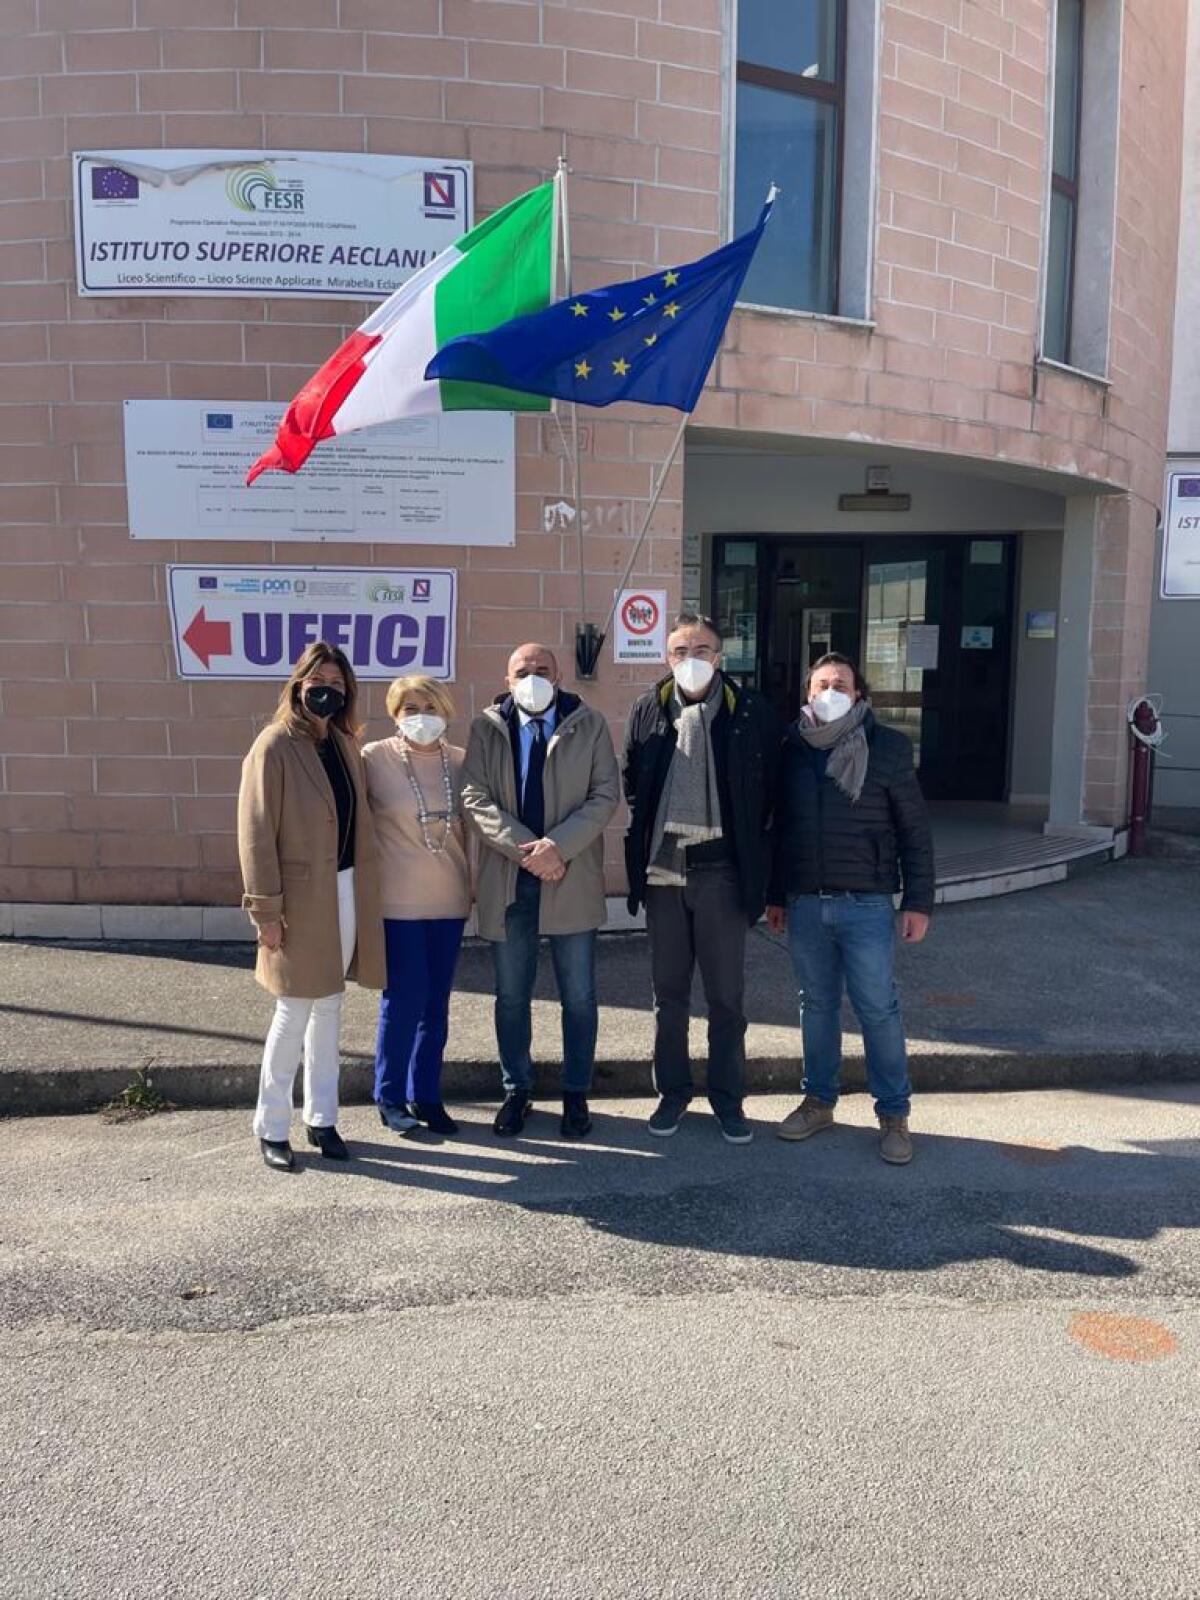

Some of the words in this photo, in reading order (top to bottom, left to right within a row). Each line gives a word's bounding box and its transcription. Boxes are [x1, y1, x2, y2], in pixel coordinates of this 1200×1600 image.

[264, 191, 304, 209] FESR
[89, 241, 190, 262] ISTITUTO
[195, 241, 325, 265] SUPERIORE
[329, 244, 437, 269] AECLANU
[117, 272, 143, 284] Liceo
[145, 272, 196, 285] Scientifico
[207, 273, 233, 285] Liceo
[235, 274, 273, 286] Scienze
[274, 275, 322, 288] Applicate
[327, 277, 374, 289] Mirabella
[262, 578, 292, 594] pon
[241, 612, 446, 668] UFFICI
